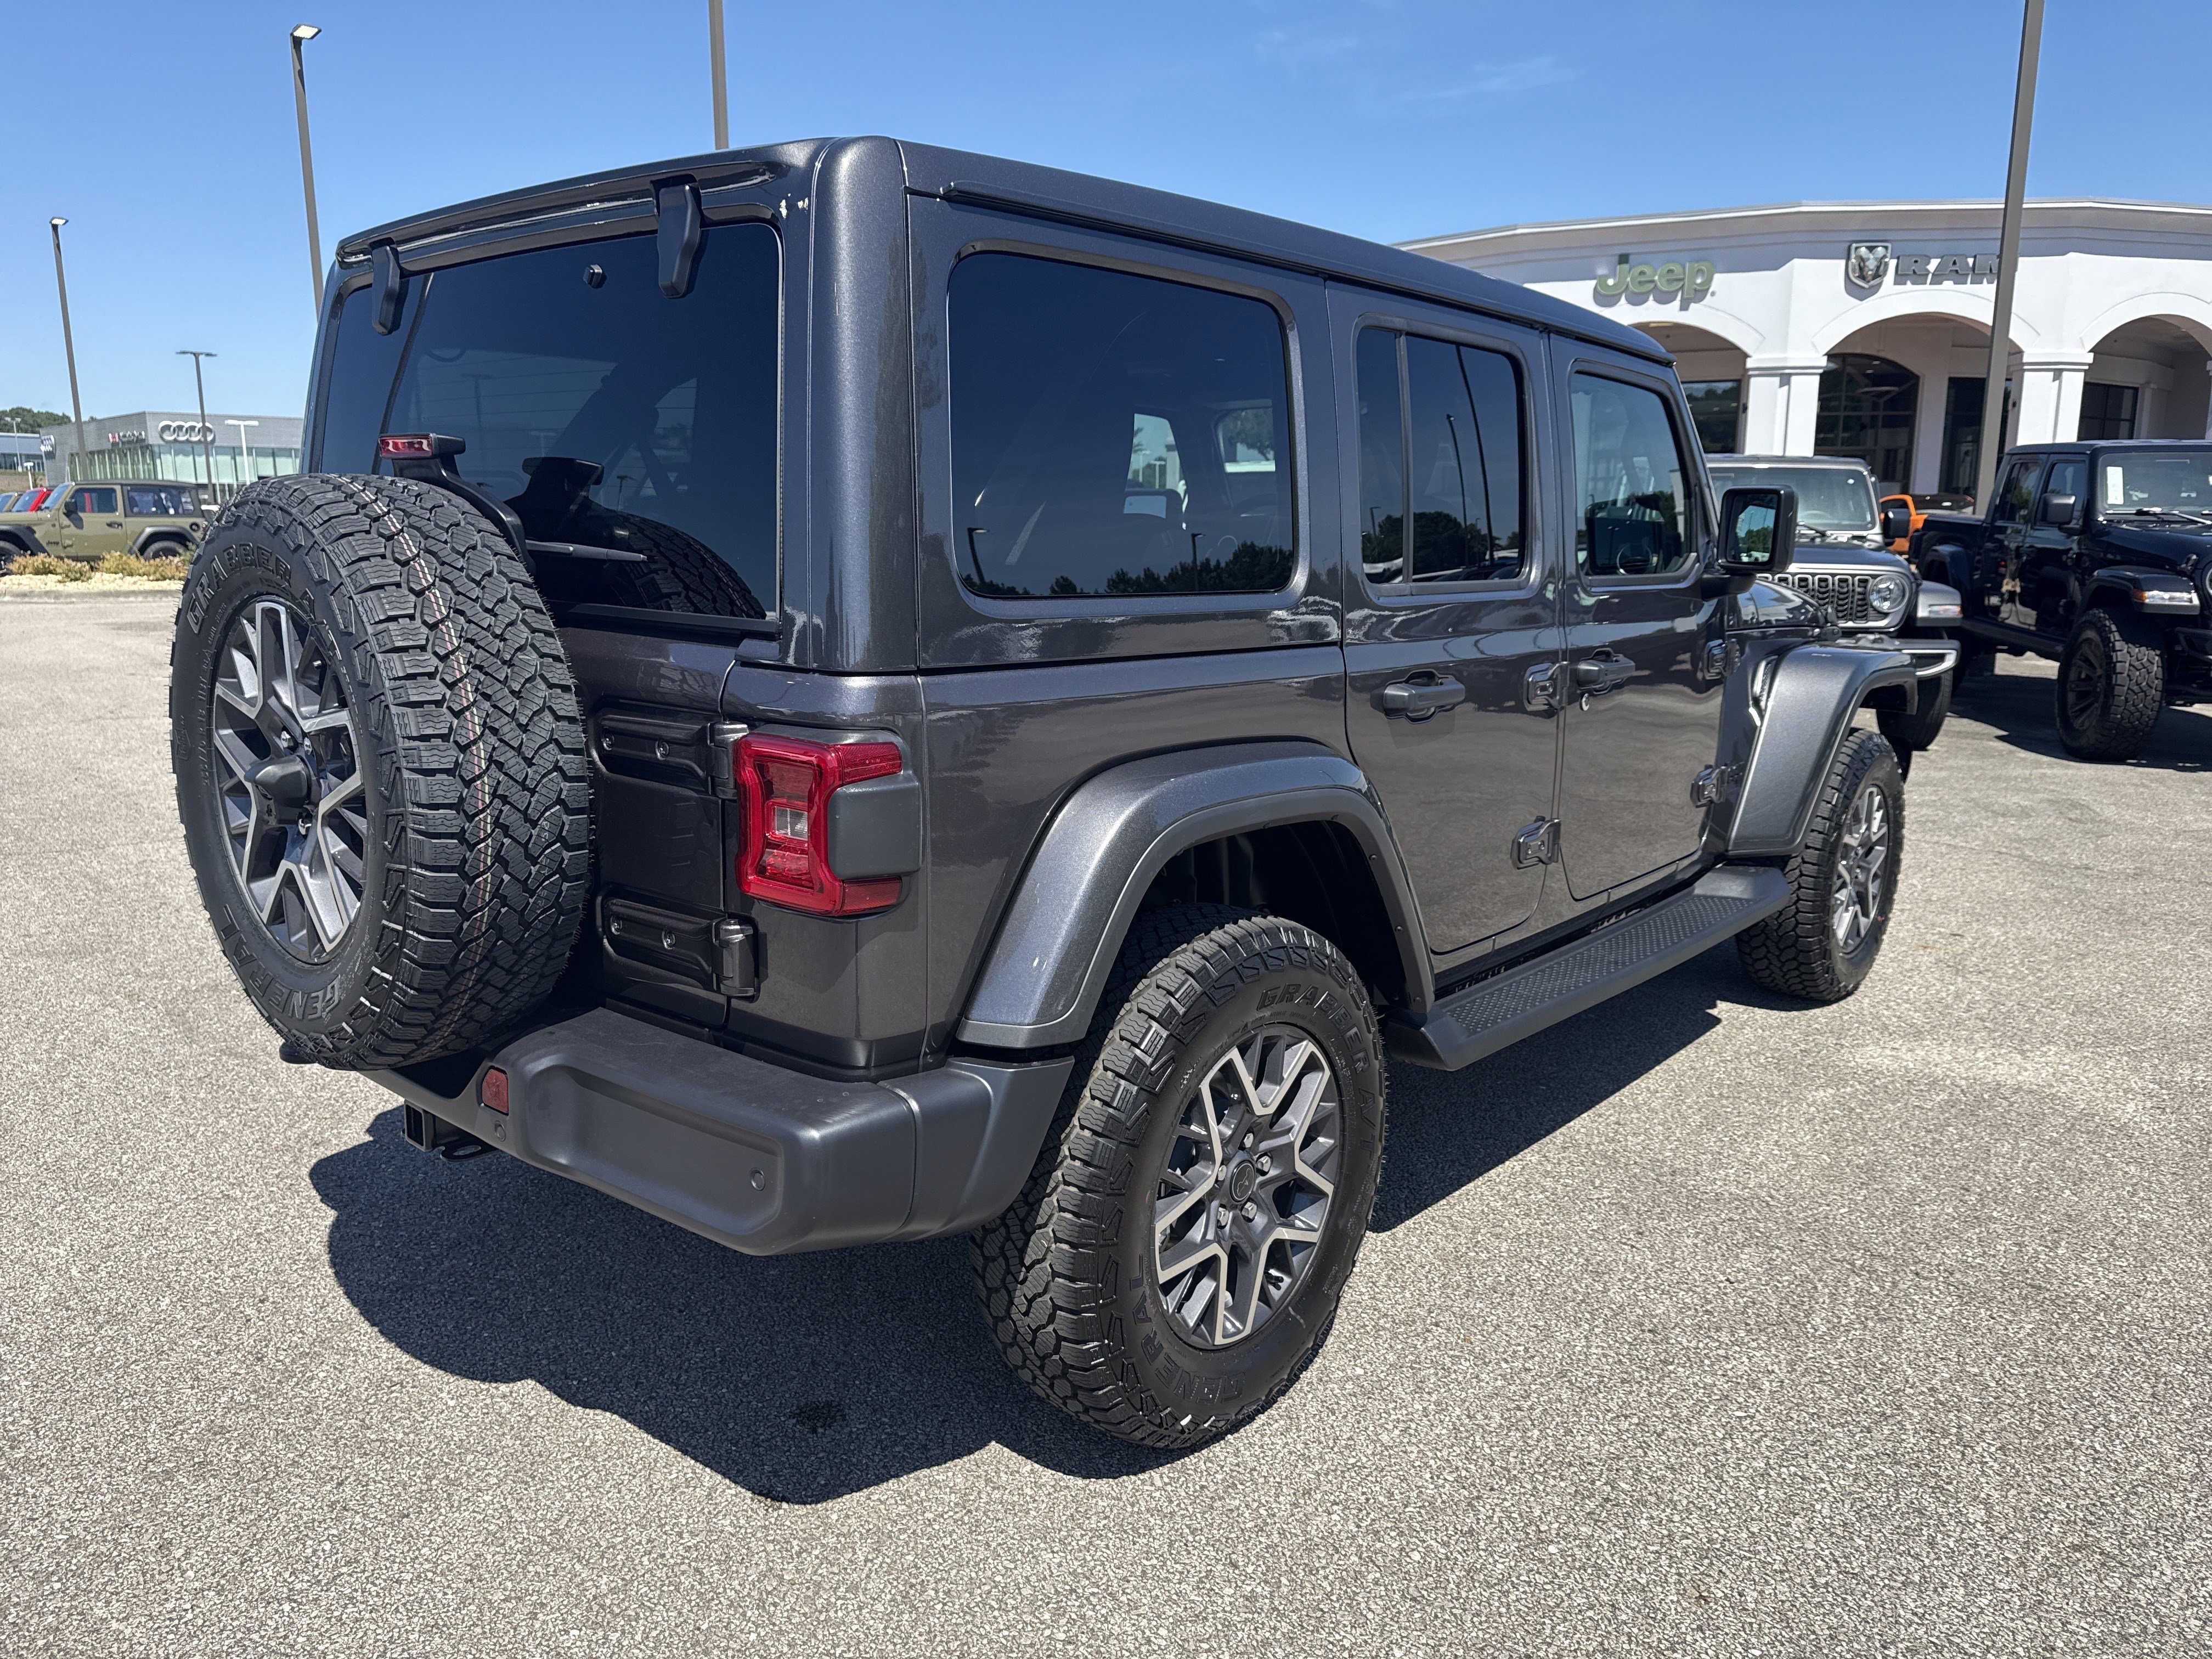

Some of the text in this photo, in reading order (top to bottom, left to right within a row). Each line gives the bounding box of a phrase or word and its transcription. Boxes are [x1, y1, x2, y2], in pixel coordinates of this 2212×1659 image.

[1597, 254, 1714, 298] Jeep
[187, 542, 292, 634] GRABBER
[221, 904, 341, 1019] GENERAL
[1256, 983, 1371, 1074] GRABBER
[1130, 1254, 1246, 1404] GENERAL
